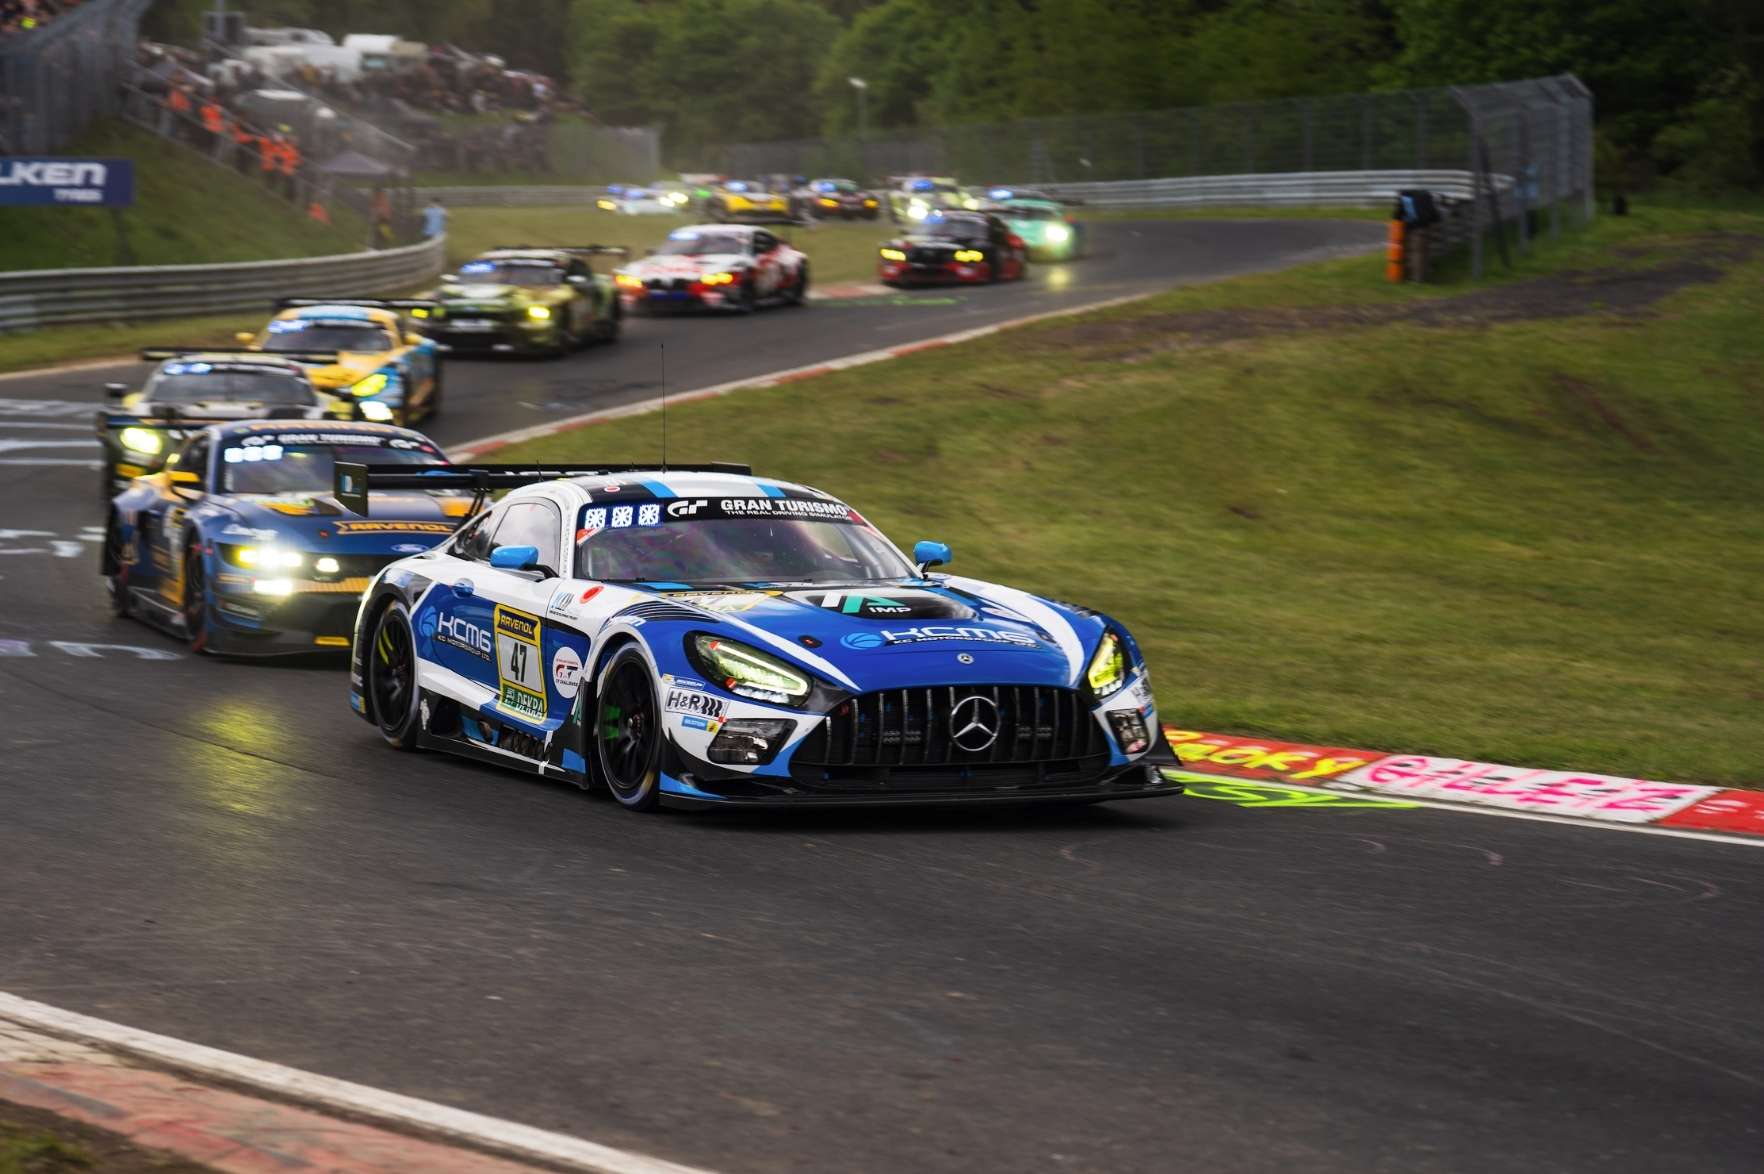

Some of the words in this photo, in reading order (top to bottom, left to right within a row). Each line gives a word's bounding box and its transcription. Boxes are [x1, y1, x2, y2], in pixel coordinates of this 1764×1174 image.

[720, 499, 773, 511] GRAN
[775, 500, 847, 515] TURISMO
[500, 614, 533, 635] RAVENOL
[510, 642, 527, 682] 47
[667, 690, 701, 711] H&R
